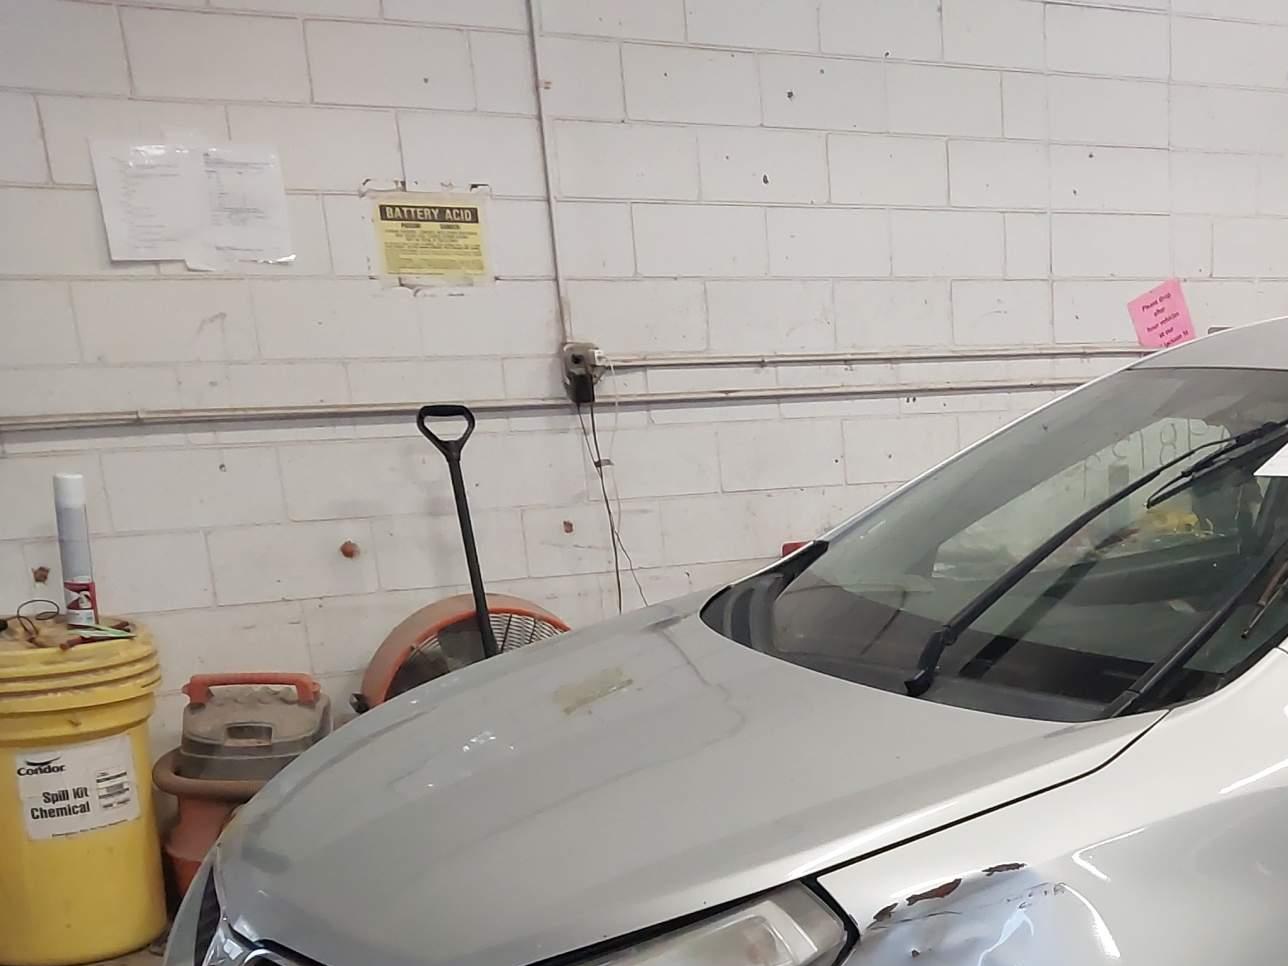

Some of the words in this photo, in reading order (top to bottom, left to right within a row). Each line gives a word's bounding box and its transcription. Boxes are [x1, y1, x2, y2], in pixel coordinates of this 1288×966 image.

[385, 206, 439, 220] BATTERY
[445, 209, 472, 221] ACID
[17, 764, 66, 776] Condor
[42, 789, 69, 804] Spill
[73, 786, 89, 801] Kit
[30, 801, 90, 820] Chemical
